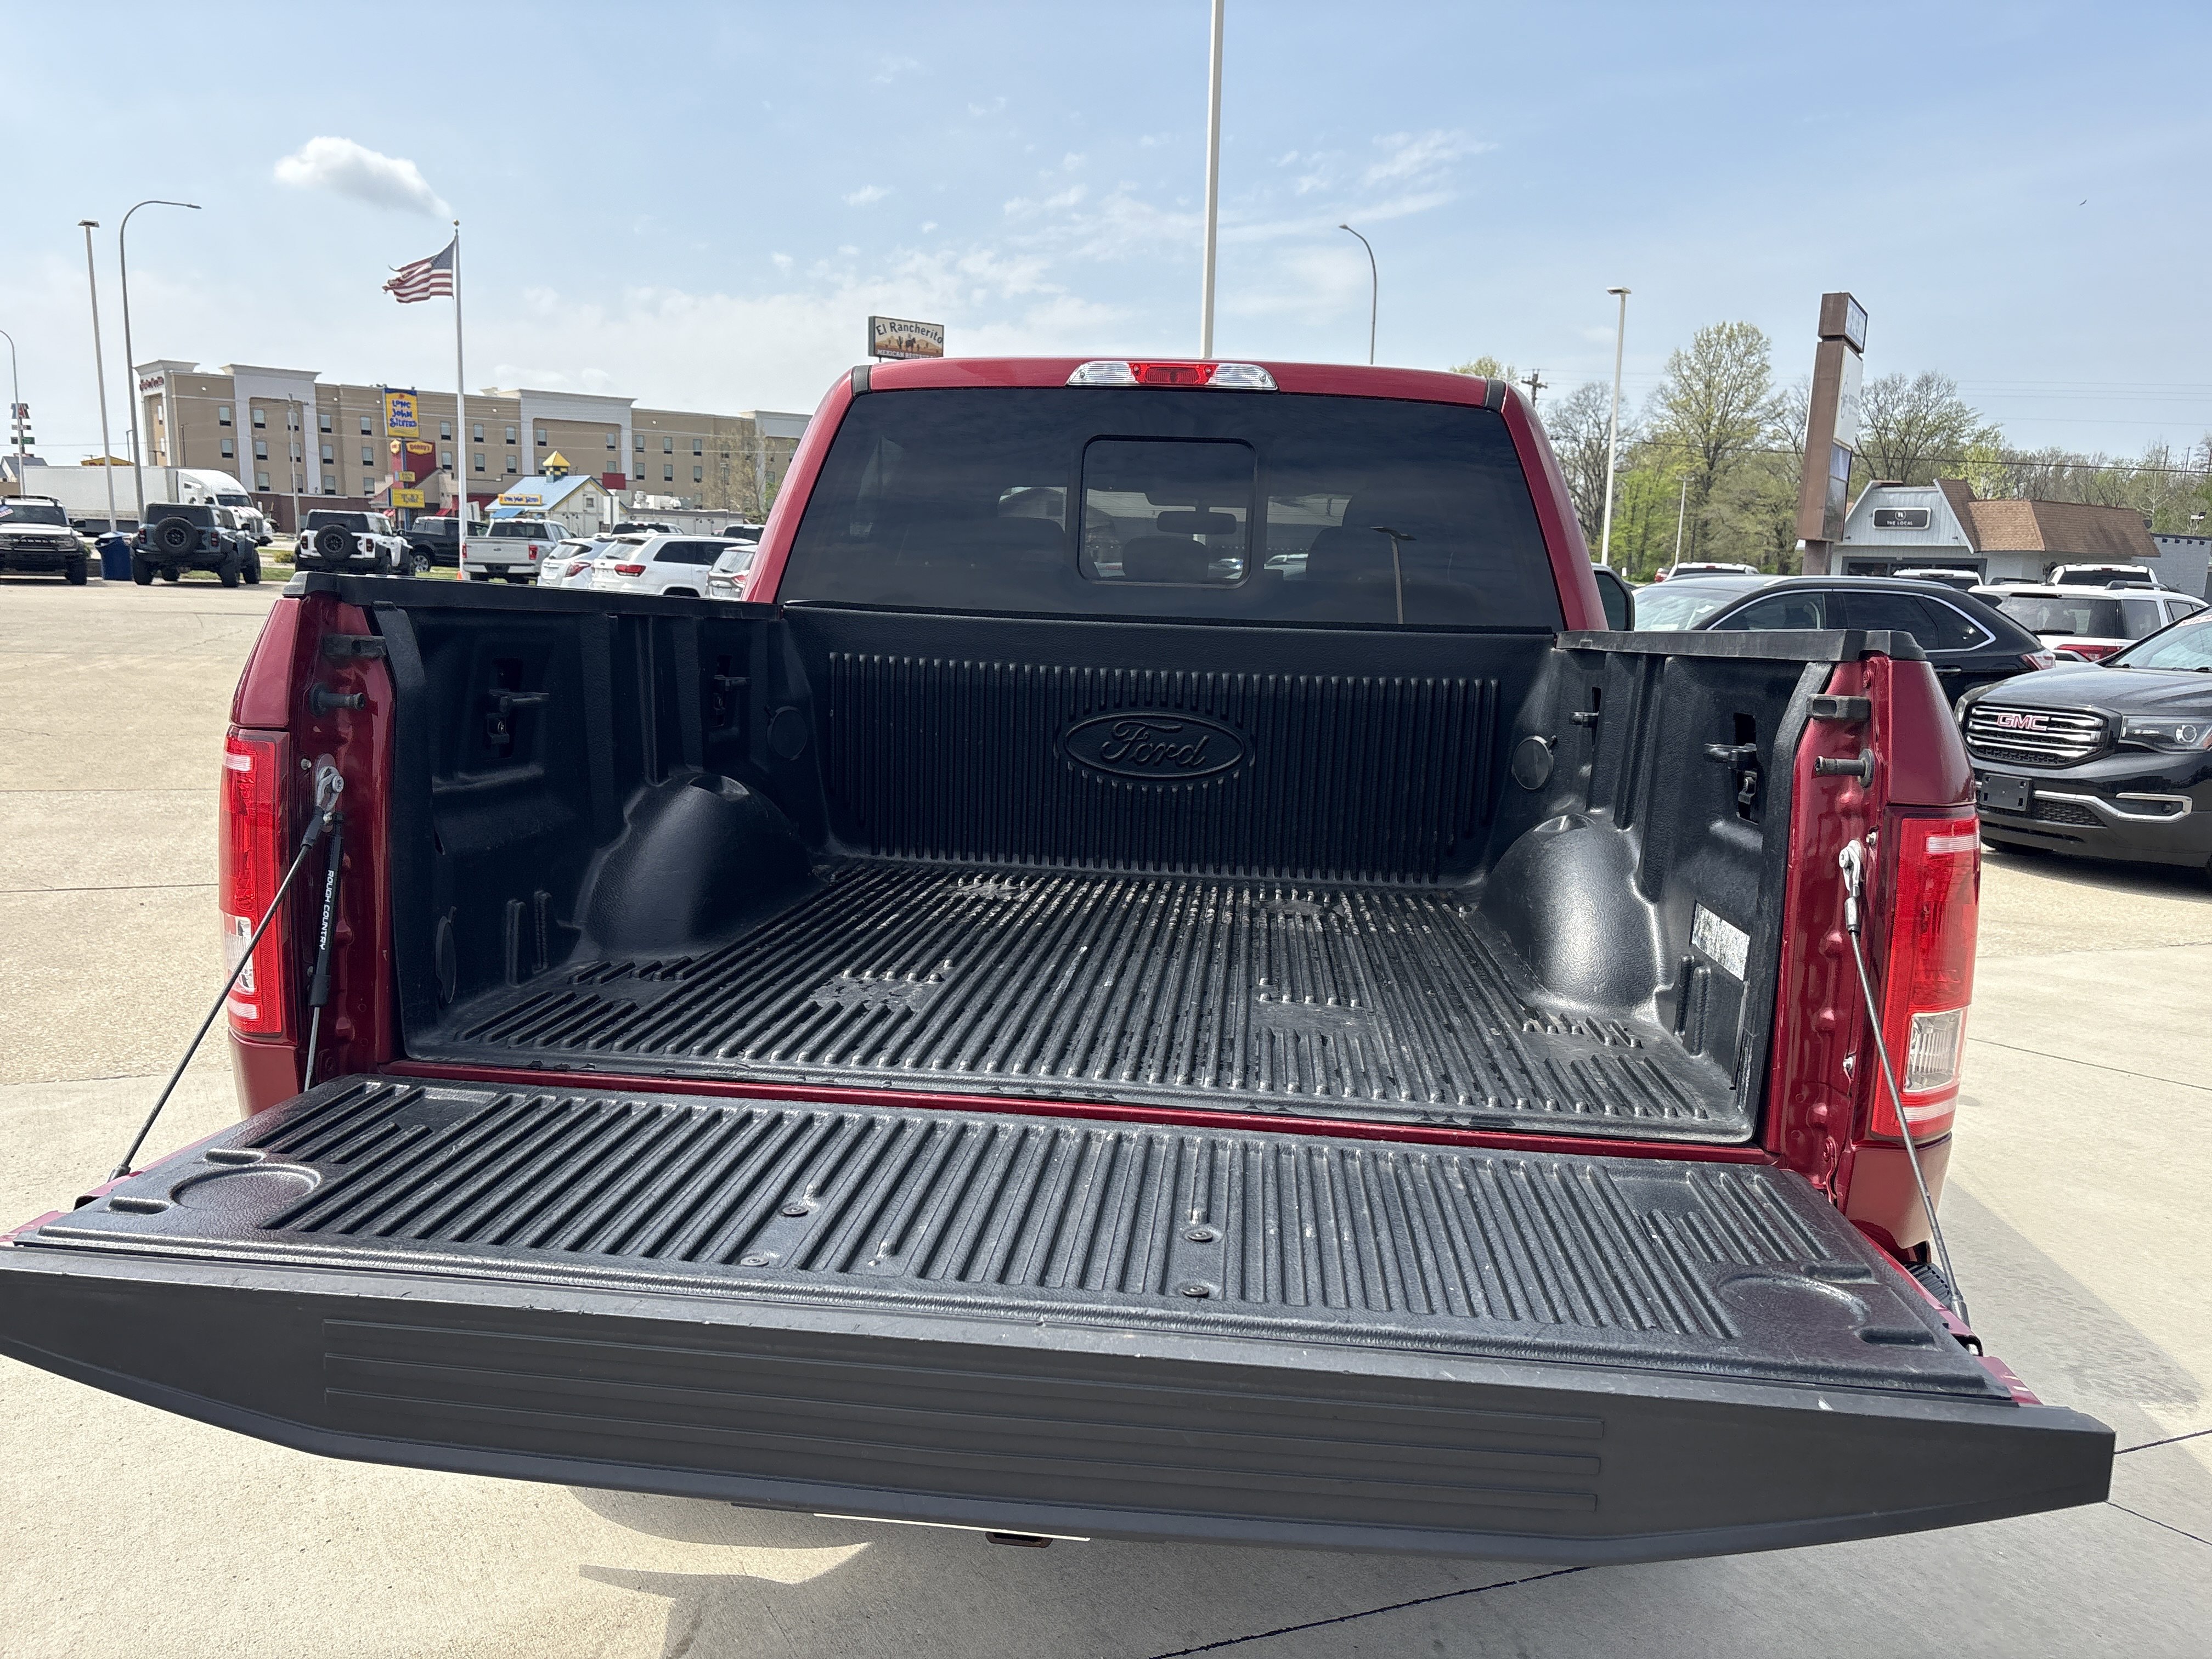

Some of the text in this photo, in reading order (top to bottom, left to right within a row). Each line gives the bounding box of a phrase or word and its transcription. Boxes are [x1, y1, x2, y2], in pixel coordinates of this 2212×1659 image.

[876, 322, 943, 343] El Rancherito
[1997, 713, 2050, 731] GMC
[1101, 720, 1210, 766] Ford
[319, 870, 334, 950] ROUGH COUNTRY
